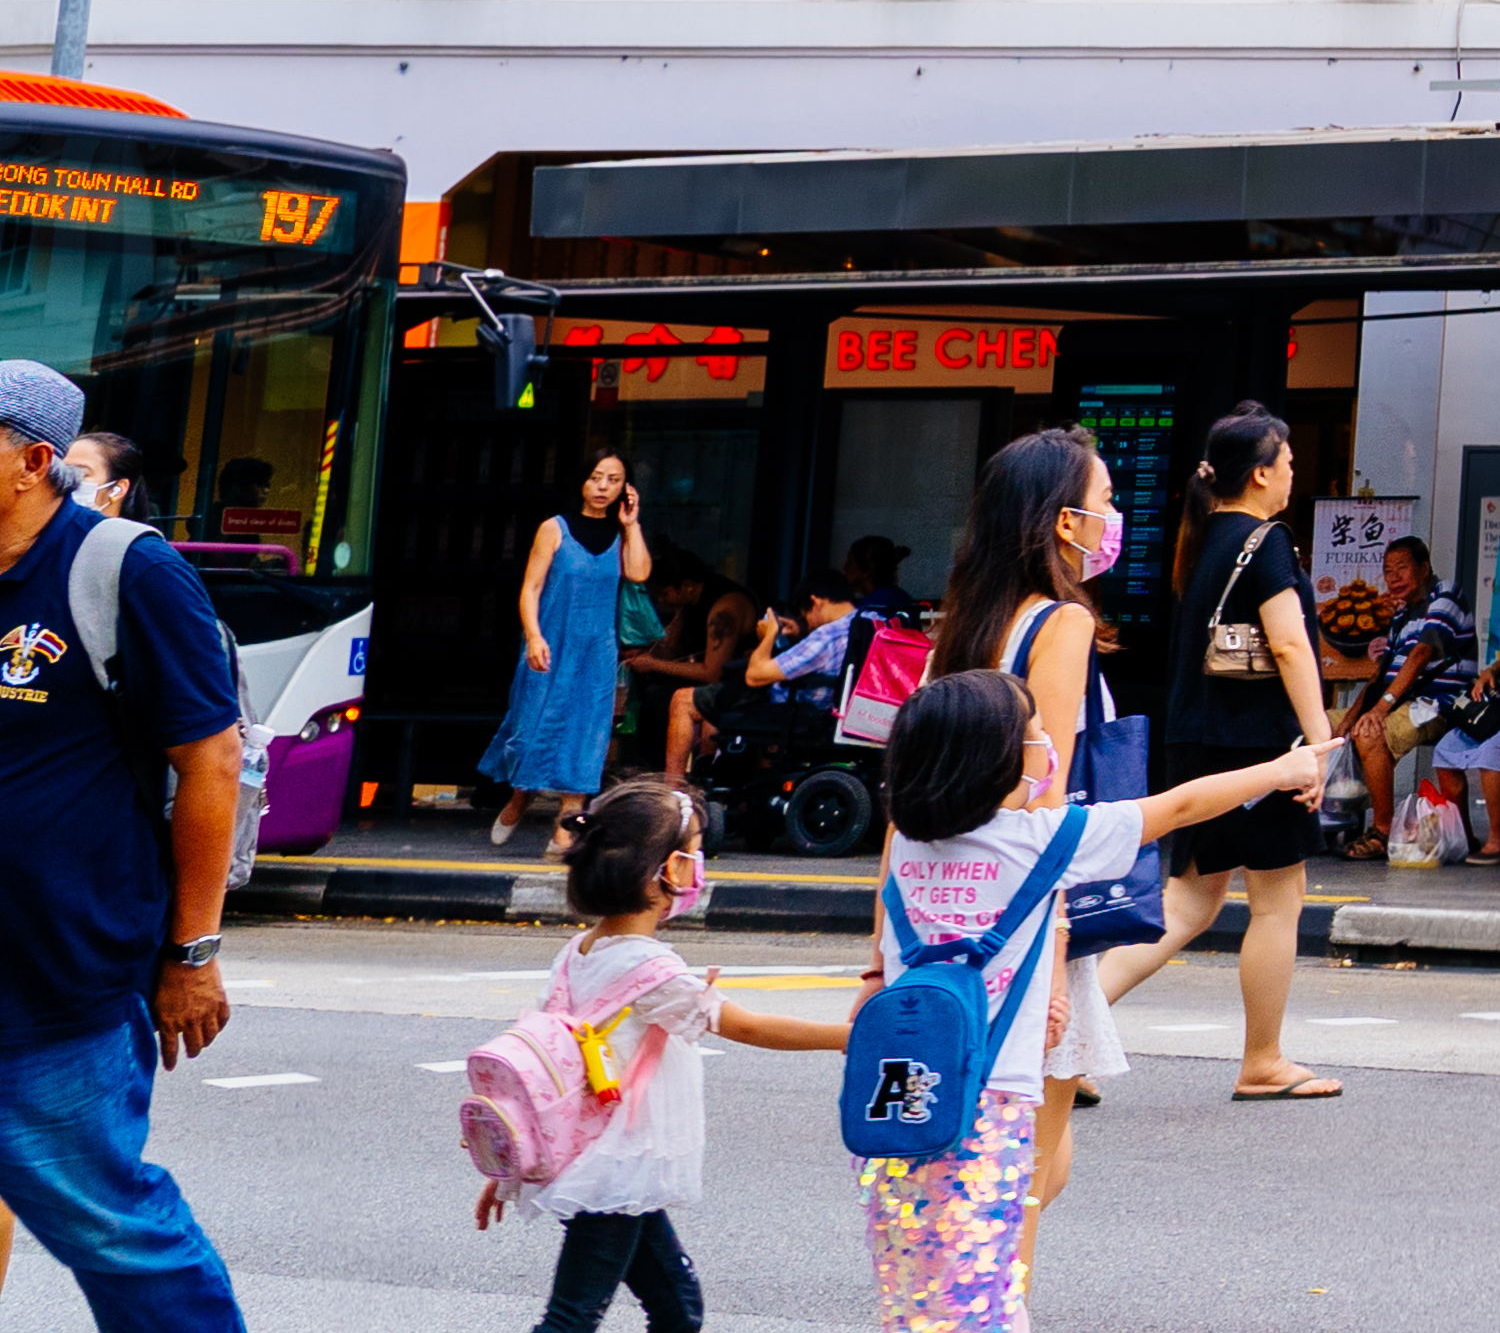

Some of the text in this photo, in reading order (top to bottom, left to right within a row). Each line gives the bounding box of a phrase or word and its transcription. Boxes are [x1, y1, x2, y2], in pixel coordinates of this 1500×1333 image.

[53, 168, 199, 201] TOWN HALL RD
[70, 195, 117, 224] INT
[260, 190, 340, 245] 197
[837, 328, 919, 373] BEE
[899, 860, 1000, 881] ONLY WHEN
[928, 886, 976, 905] GETS
